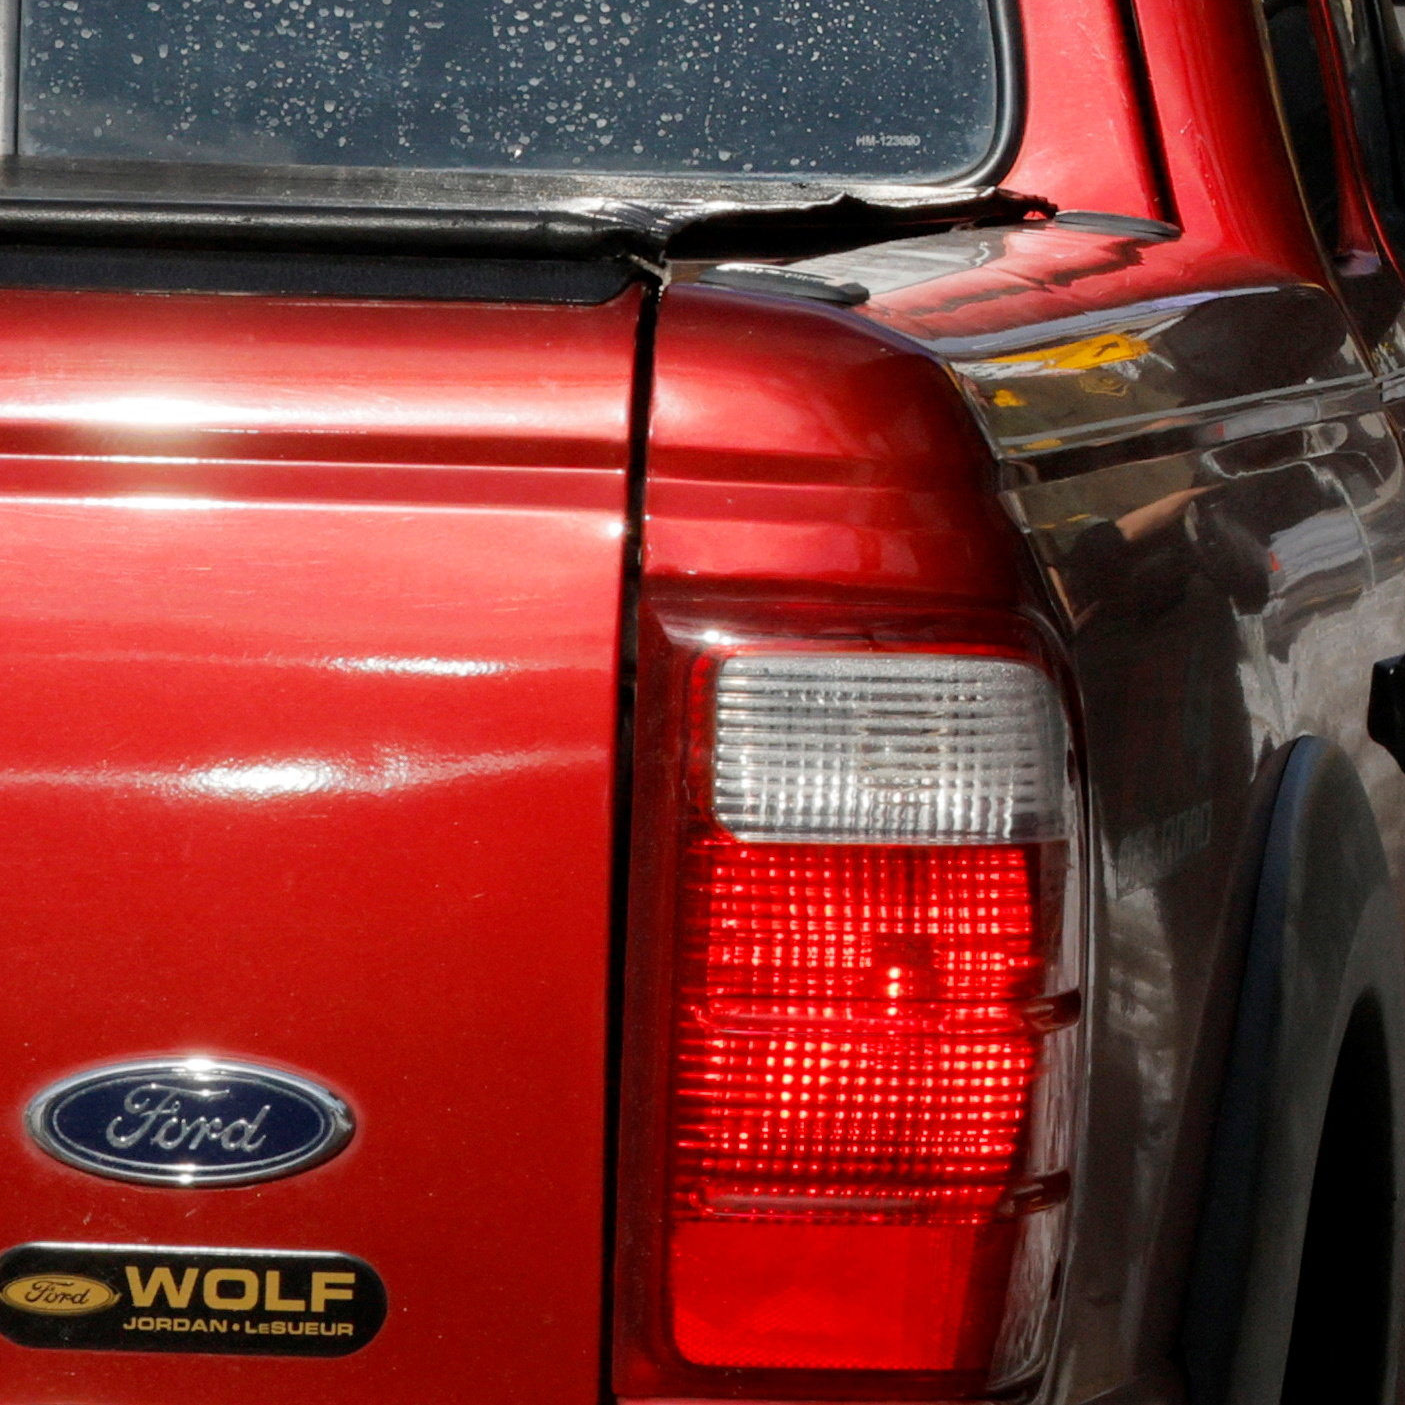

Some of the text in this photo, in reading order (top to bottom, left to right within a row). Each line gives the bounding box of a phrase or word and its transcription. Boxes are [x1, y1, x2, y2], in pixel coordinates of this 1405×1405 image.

[106, 1083, 272, 1152] Ford
[24, 1280, 90, 1305] Ford
[125, 1266, 356, 1313] WOLF
[123, 1317, 228, 1334] JORDAN
